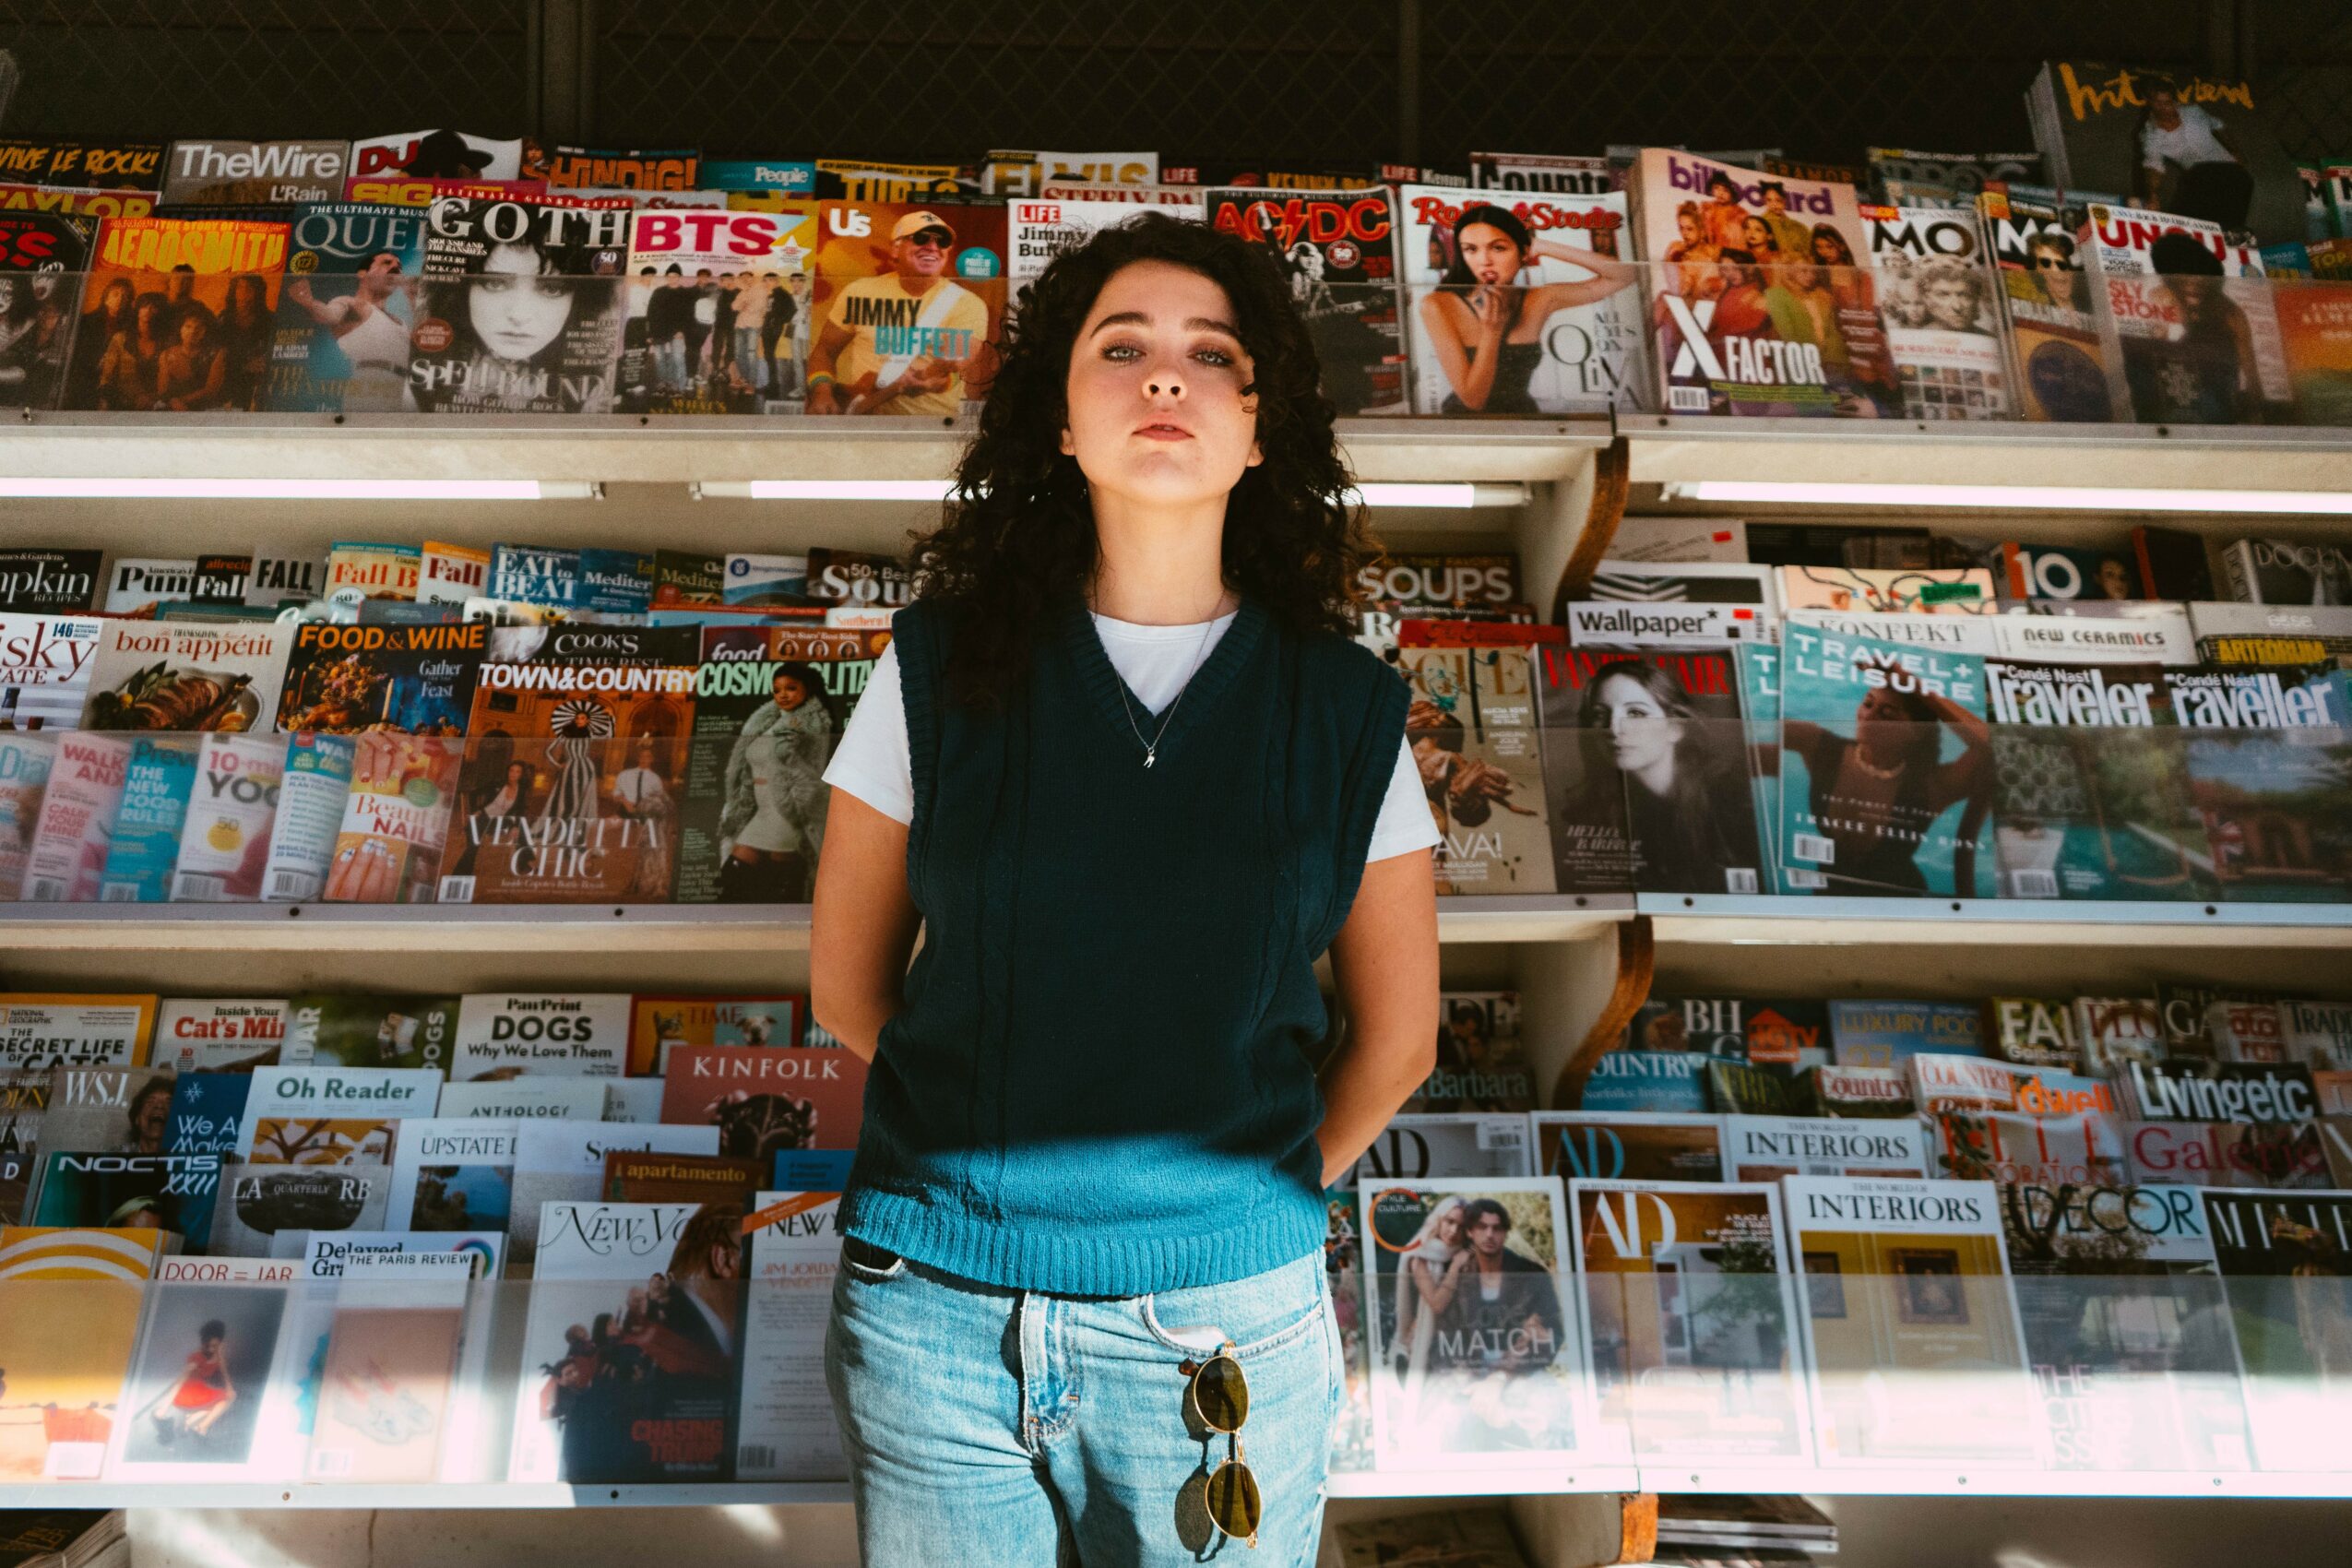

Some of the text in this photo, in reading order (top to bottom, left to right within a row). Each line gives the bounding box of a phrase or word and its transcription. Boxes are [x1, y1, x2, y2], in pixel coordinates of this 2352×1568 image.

[51, 148, 84, 174] LE
[85, 148, 160, 175] ROCK!
[176, 144, 342, 178] TheWire
[756, 166, 809, 190] People
[1163, 167, 1198, 184] LIFE
[1382, 165, 1421, 183] LIFE
[335, 206, 397, 220] ULTIMATE
[429, 196, 631, 247] GOTH
[1017, 205, 1060, 227] LIFE
[635, 215, 778, 255] BTS
[102, 229, 286, 275] AEROSMITH
[842, 297, 921, 327] JIMMY
[874, 327, 974, 360] BUFFETT
[1663, 294, 1728, 381] X
[1726, 335, 1828, 386] FACTOR
[256, 559, 313, 591] FALL
[334, 562, 386, 591] Fall
[426, 557, 481, 587] Fall
[496, 553, 558, 577] EAT
[557, 568, 576, 583] to
[496, 574, 577, 600] BEAT
[1358, 566, 1514, 602] SOUPS
[300, 628, 485, 650] FOOD & WINE
[554, 633, 639, 656] COOK'S
[1818, 621, 1968, 644] KONFEKT
[2023, 629, 2167, 647] NEW CERAMICS
[116, 628, 275, 666] bon appétit
[419, 659, 464, 677] Gather
[479, 663, 698, 697] TOWN&COUNTRY
[1793, 653, 1976, 707] LEISURE
[2055, 670, 2091, 687] Nast
[420, 683, 456, 700] Feast
[1984, 662, 2155, 728] Traveler
[132, 765, 164, 781] THE
[210, 750, 239, 771] 10
[128, 780, 170, 794] NEW
[124, 794, 182, 812] FOOD
[120, 812, 178, 827] RULES
[469, 814, 661, 850] VENDETTA
[509, 847, 606, 878] CHIC
[214, 1006, 282, 1019] Inside Your
[10, 1028, 34, 1039] THE
[174, 1017, 237, 1039] Cat's
[491, 1015, 593, 1043] DOGS
[8, 1054, 23, 1065] OF
[81, 1039, 126, 1056] LIFE
[468, 1043, 613, 1061] Why We Love Them
[693, 1055, 841, 1081] KINFOLK
[277, 1076, 415, 1104] Oh Reader
[2020, 1075, 2114, 1114] dwell
[2130, 1060, 2315, 1125] Livingetc
[470, 1105, 571, 1119] ANTHOLOGY
[178, 1114, 214, 1136] We
[421, 1136, 507, 1157] UPSTATE
[1746, 1131, 1910, 1159] INTERIORS
[2133, 1125, 2330, 1175] Galerie
[57, 1154, 220, 1171] NOCTIS
[160, 1172, 219, 1196] XXII
[230, 1177, 263, 1200] LA
[627, 1165, 746, 1188] apartamento
[1806, 1194, 1983, 1223] INTERIORS
[2024, 1186, 2203, 1235] DECOR
[1586, 1189, 1678, 1259] AD
[350, 1255, 470, 1267] THE PARIS REVIEW
[1437, 1328, 1557, 1358] MATCH
